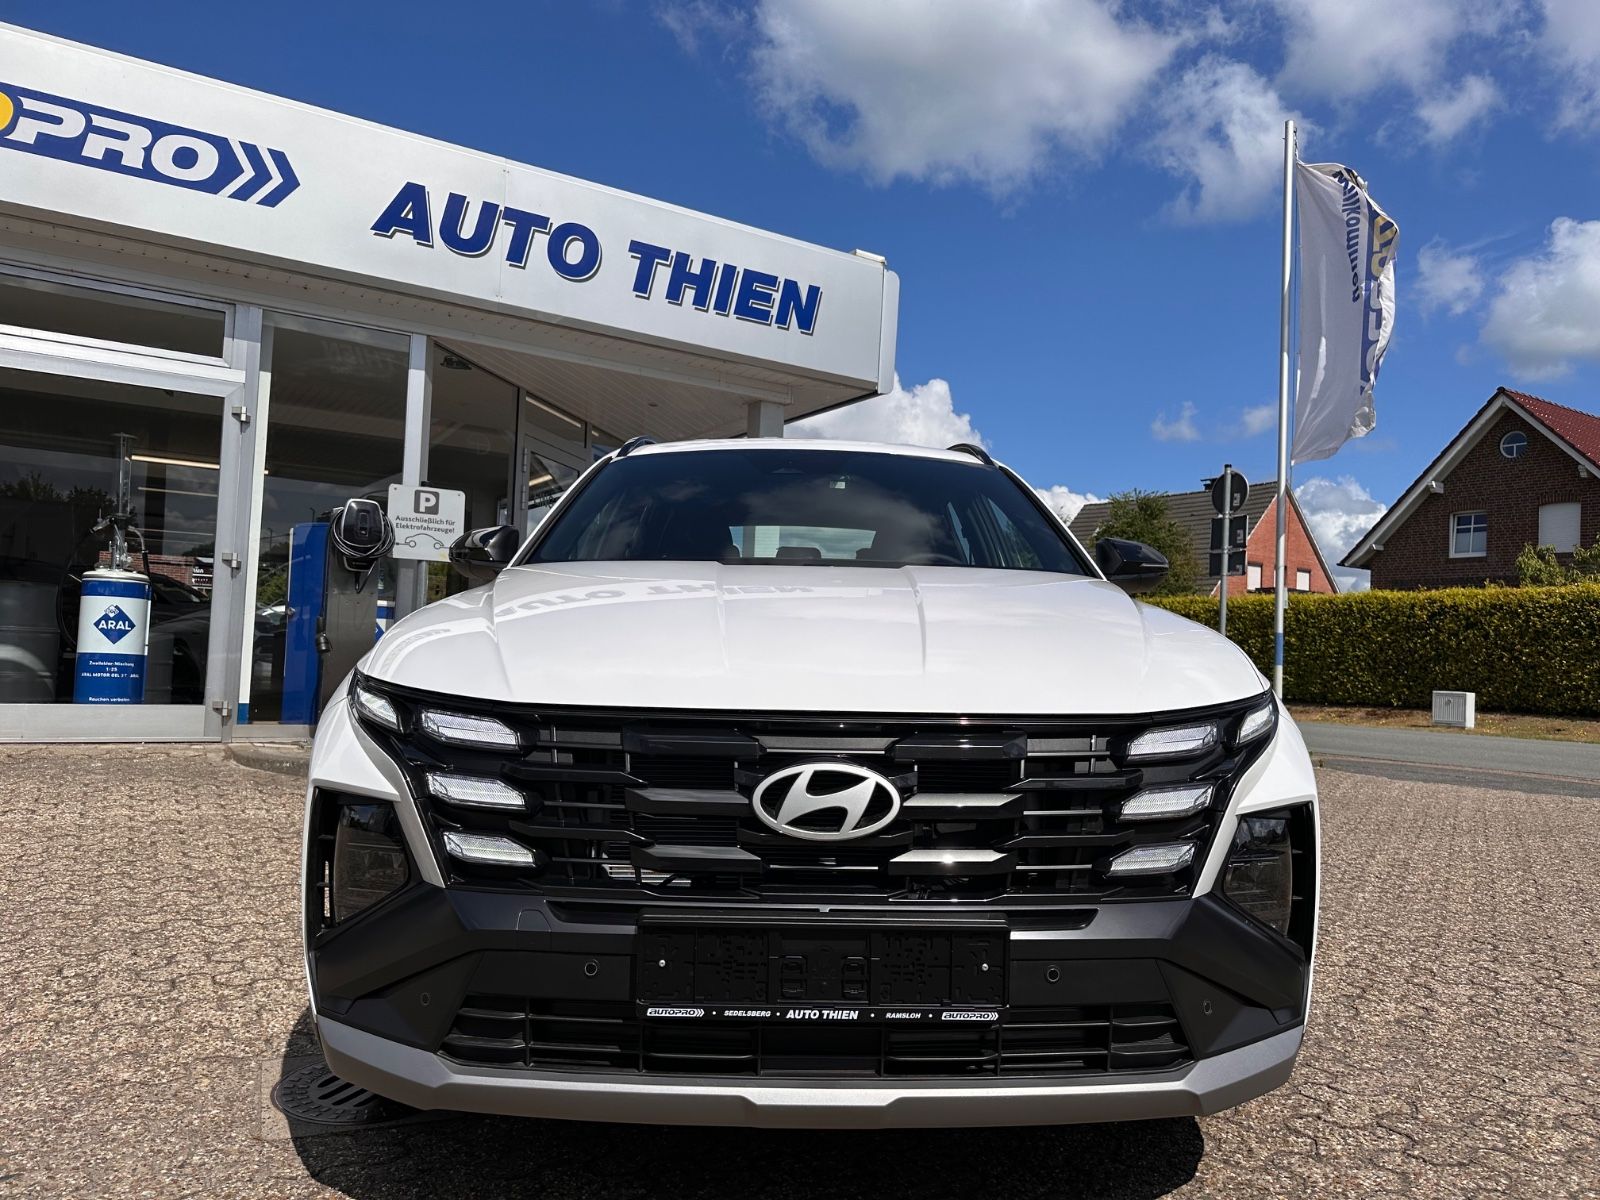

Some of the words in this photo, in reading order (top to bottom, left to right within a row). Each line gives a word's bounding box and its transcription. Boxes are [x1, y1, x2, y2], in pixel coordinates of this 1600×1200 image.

[0, 91, 219, 182] PRO
[370, 181, 602, 282] AUTO
[628, 239, 822, 335] THIEN
[419, 492, 437, 512] P
[395, 515, 445, 525] Ausschließlich
[98, 620, 131, 630] ARAL
[786, 1010, 820, 1019] AUTO
[821, 1010, 859, 1020] THIEN
